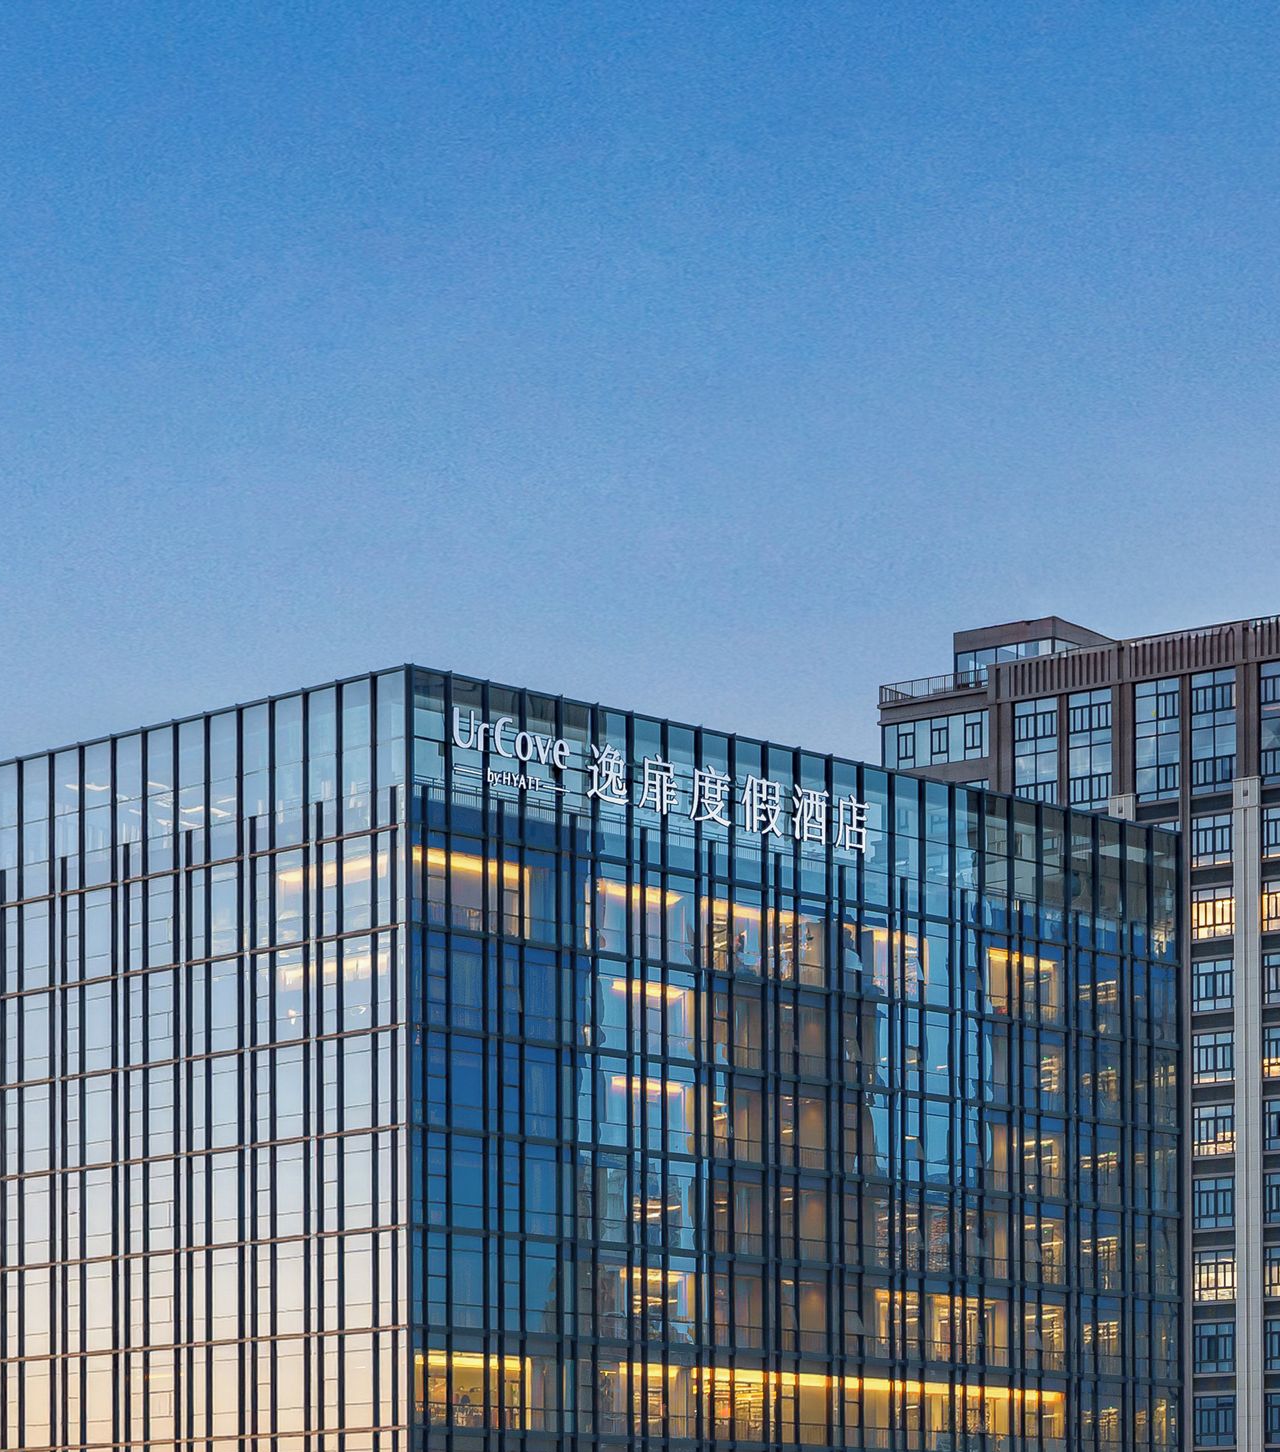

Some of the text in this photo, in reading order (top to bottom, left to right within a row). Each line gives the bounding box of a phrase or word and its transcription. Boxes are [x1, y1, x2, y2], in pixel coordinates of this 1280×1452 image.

[452, 706, 570, 770] UrCove
[487, 768, 541, 792] by HYATT
[586, 743, 871, 853] 逸扉度假酒店
